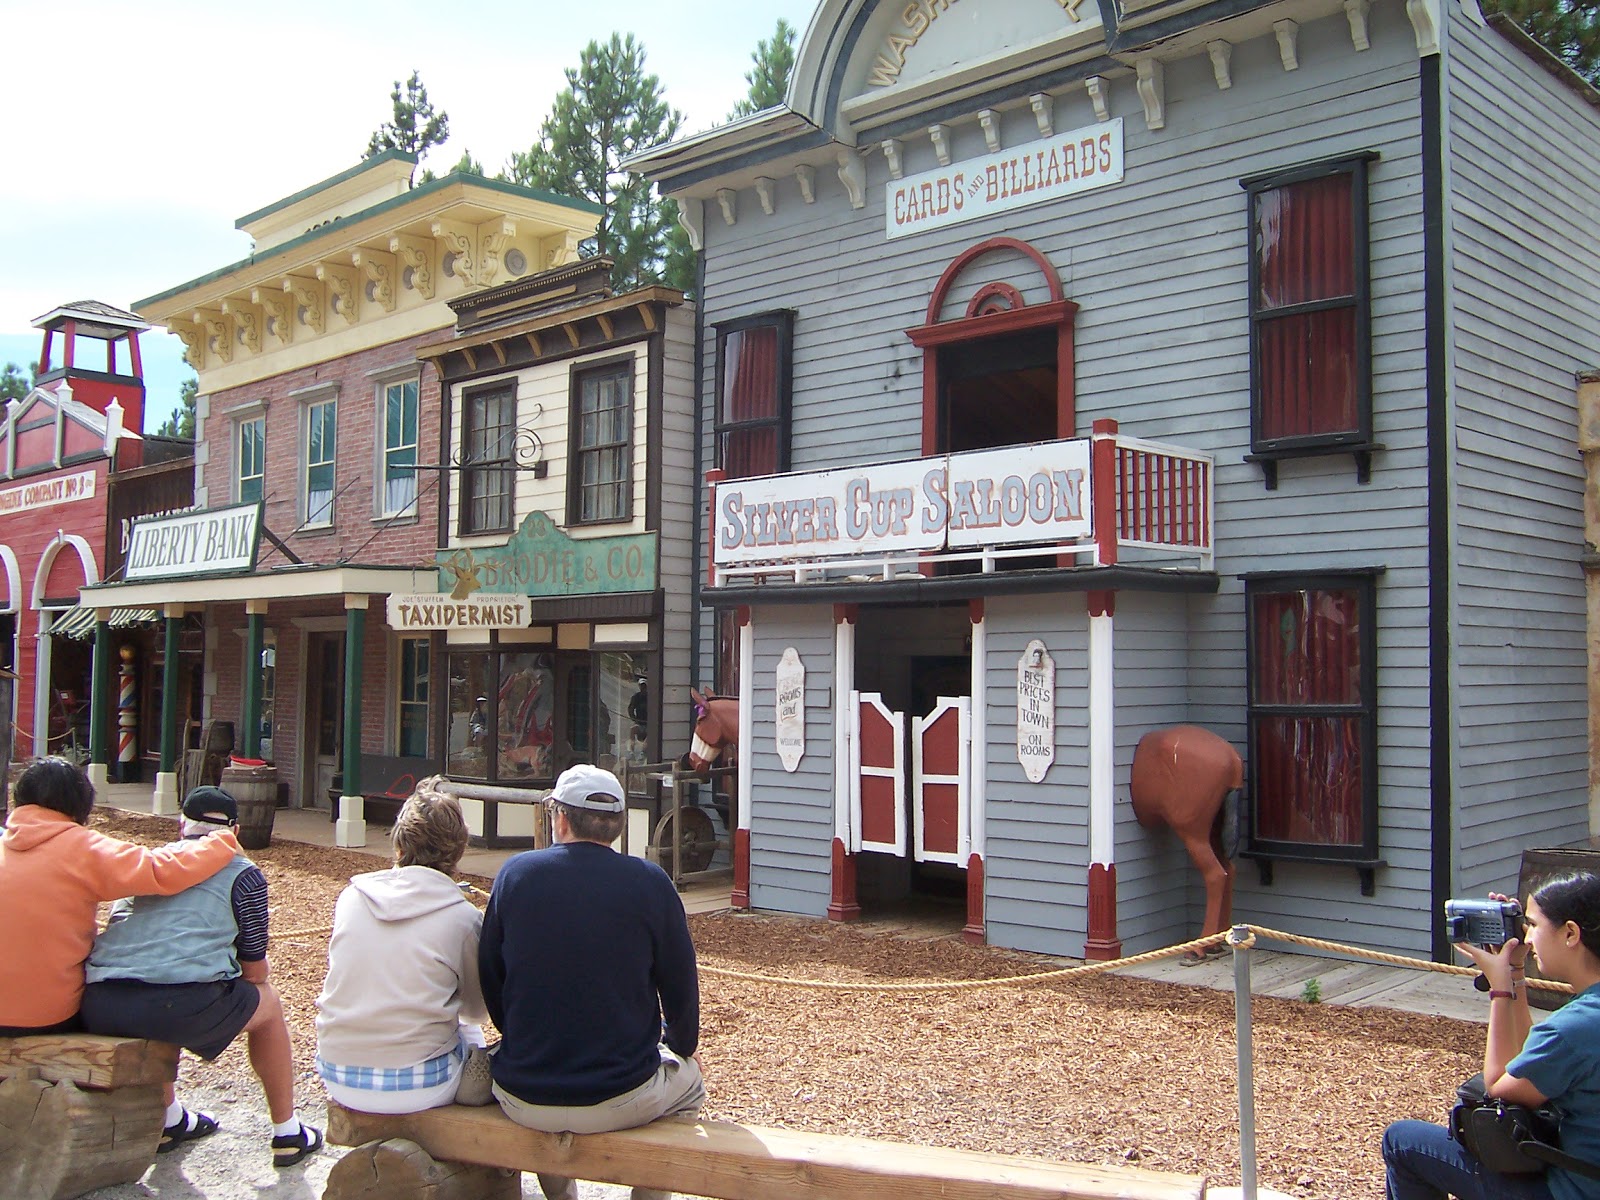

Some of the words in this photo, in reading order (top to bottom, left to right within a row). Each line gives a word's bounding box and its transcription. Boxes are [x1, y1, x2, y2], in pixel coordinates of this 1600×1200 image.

[894, 172, 965, 226] CARDS
[967, 173, 985, 198] AND
[985, 132, 1112, 203] BILLIARDS
[721, 491, 839, 550] SILVER
[845, 478, 915, 540] CUP
[921, 467, 1085, 534] SALOON
[130, 521, 205, 570] LIBERTY
[203, 513, 255, 562] BANK
[485, 550, 576, 587] BRODIE
[584, 556, 599, 583] &
[398, 604, 524, 627] TAXIDERMIST
[1024, 670, 1045, 688] BEST
[1019, 681, 1050, 702] PRICES
[1030, 699, 1040, 712] IN
[1021, 708, 1049, 729] TOWN
[1020, 744, 1050, 757] ROOMS
[1028, 734, 1042, 746] ON
